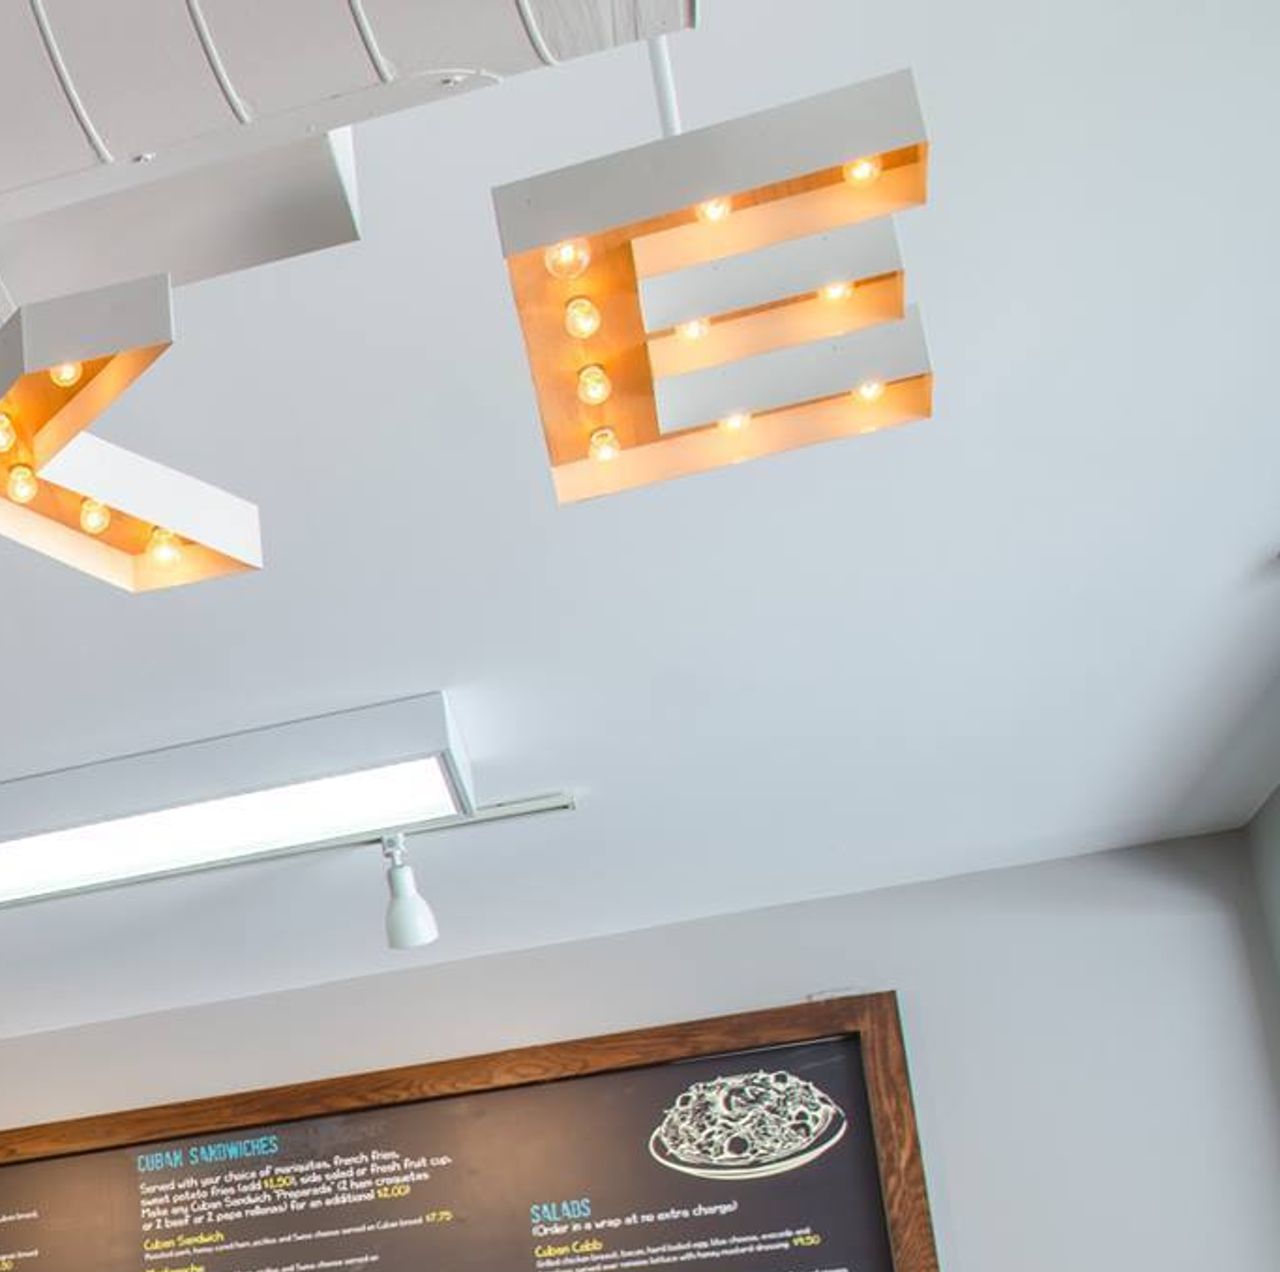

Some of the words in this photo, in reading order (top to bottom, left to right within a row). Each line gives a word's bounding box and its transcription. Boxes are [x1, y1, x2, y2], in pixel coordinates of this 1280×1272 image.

[136, 1151, 183, 1171] CUBAN
[188, 1136, 279, 1163] SANDWICHES
[530, 1199, 591, 1222] SALADS
